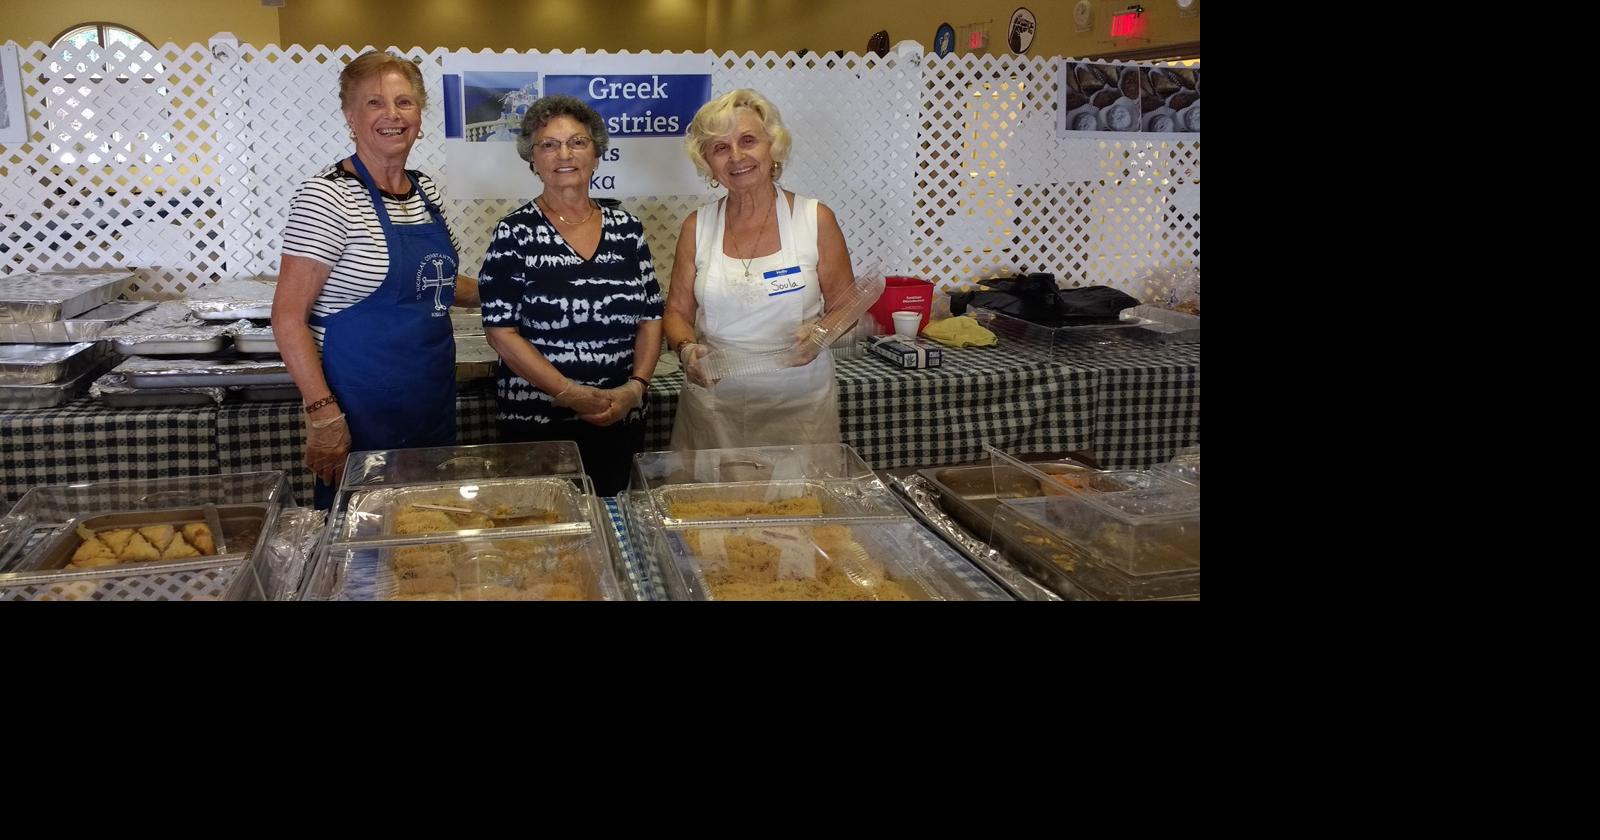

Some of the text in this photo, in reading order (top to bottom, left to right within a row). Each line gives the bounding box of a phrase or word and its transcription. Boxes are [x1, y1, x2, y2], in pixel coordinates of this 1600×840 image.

[588, 75, 669, 100] Greek
[607, 110, 680, 133] stries
[770, 278, 799, 292] Soula
